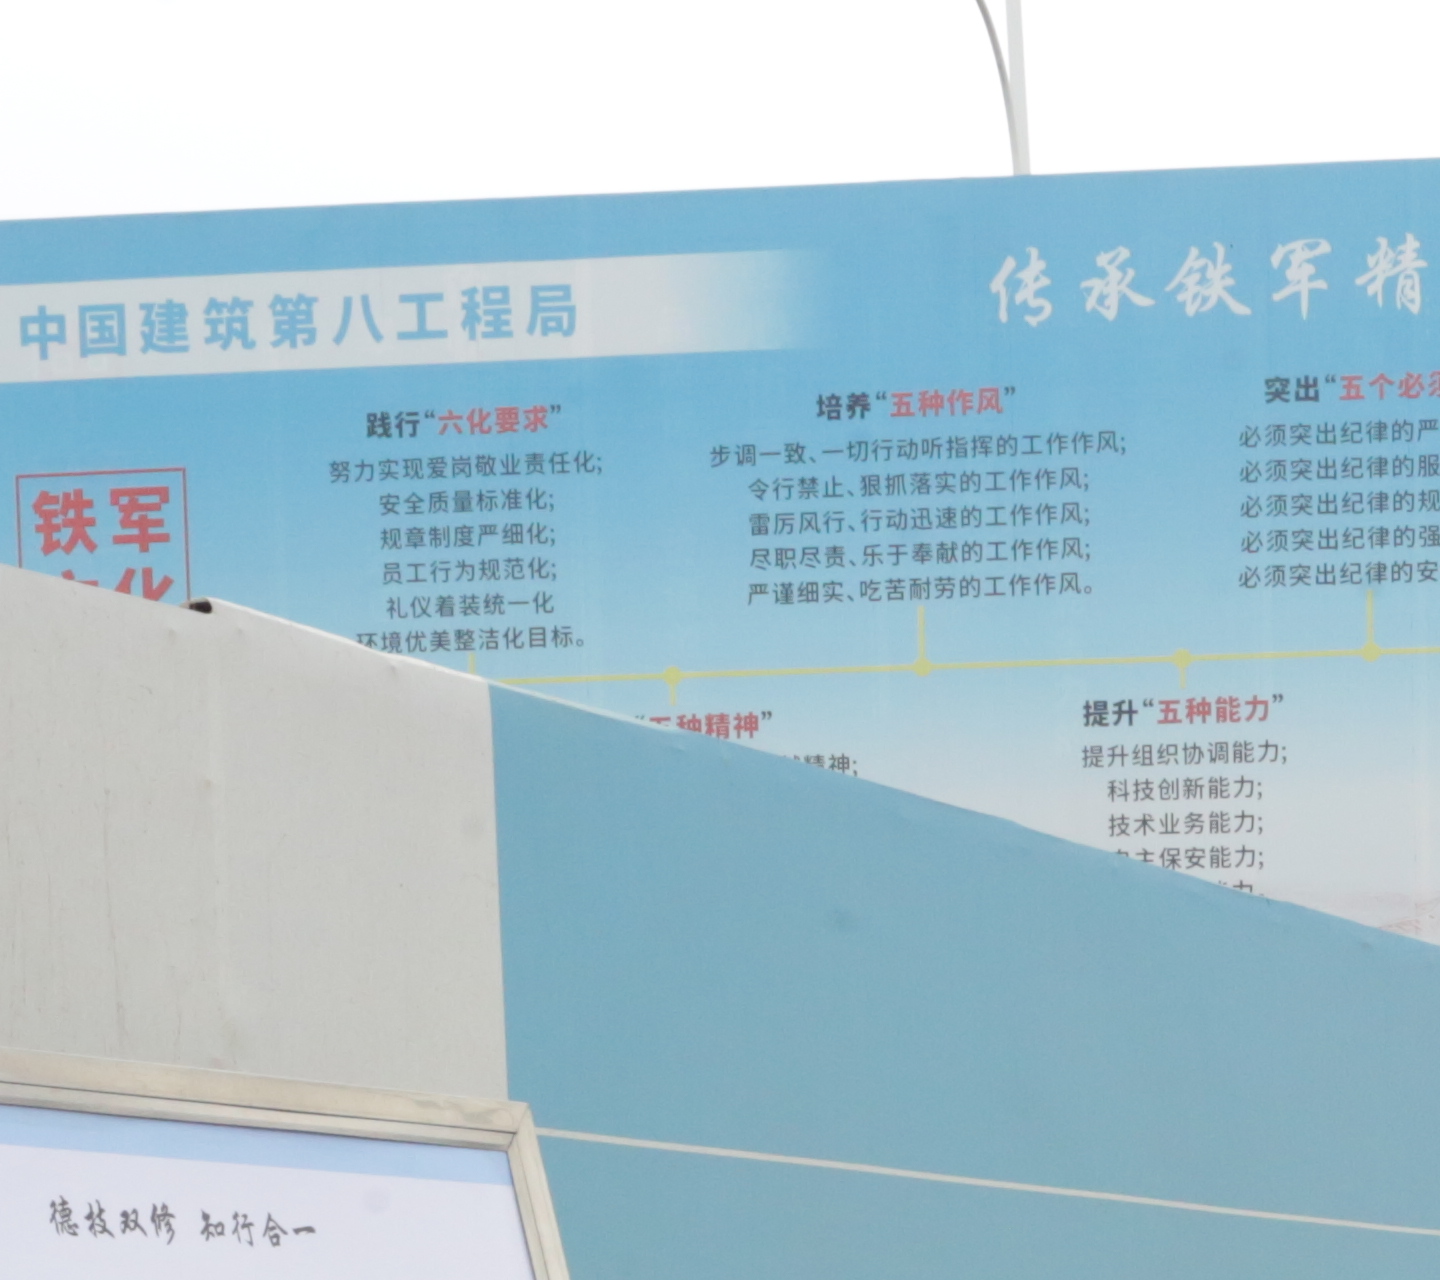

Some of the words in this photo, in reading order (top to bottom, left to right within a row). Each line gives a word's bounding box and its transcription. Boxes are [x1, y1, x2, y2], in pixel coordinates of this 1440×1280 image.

[19, 283, 579, 362] 中国建筑第八工程局
[328, 451, 604, 483] 努力实现爱岗敬业责任化；
[378, 486, 556, 517] 安全质量标准化；
[31, 485, 172, 556] 铁军
[379, 520, 557, 551] 规章制度严细化；
[380, 554, 558, 586] 员工行为规范化；
[747, 571, 1094, 607] 严谨细实、吃苦耐劳的工作作风。
[385, 590, 555, 621] 礼仪着装统一化
[1081, 739, 1288, 770] 提升组织协调能力；
[1107, 774, 1264, 804] 科技创新能力；
[1107, 809, 1265, 838] 技术业务能力；
[49, 1194, 176, 1245] 德技双修
[199, 1209, 317, 1248] 知行合一
